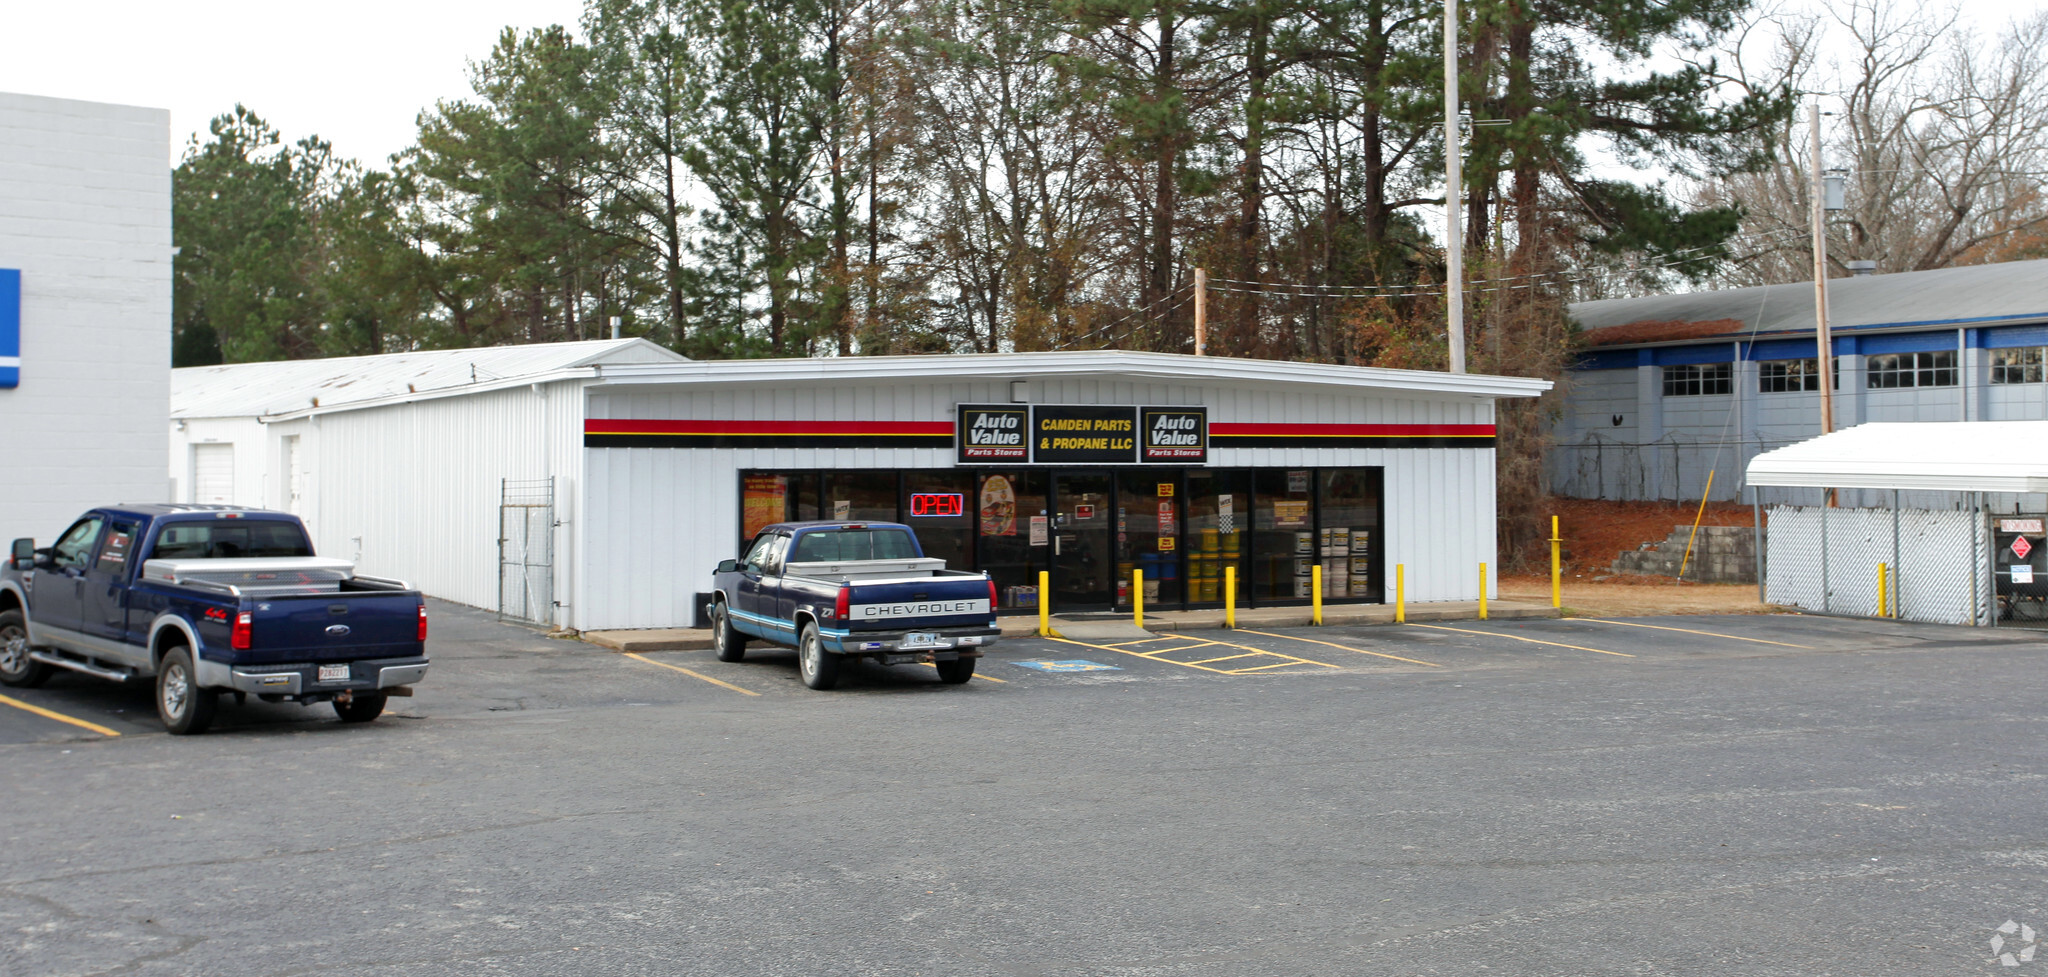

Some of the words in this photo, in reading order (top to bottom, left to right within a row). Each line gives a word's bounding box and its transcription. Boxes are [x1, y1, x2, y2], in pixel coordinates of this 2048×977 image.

[973, 413, 1018, 429] Auto
[1041, 419, 1091, 431] CAMDEN
[1094, 419, 1132, 431] PARTS
[1154, 414, 1196, 430] Auto
[970, 429, 1020, 445] Value
[1040, 438, 1050, 449] &
[1052, 438, 1108, 449] PROPANE
[1110, 438, 1133, 450] LLC
[1151, 430, 1198, 446] Value
[744, 497, 783, 507] WELCOME
[912, 494, 962, 515] OPEN
[865, 602, 976, 616] CHEVROLET
